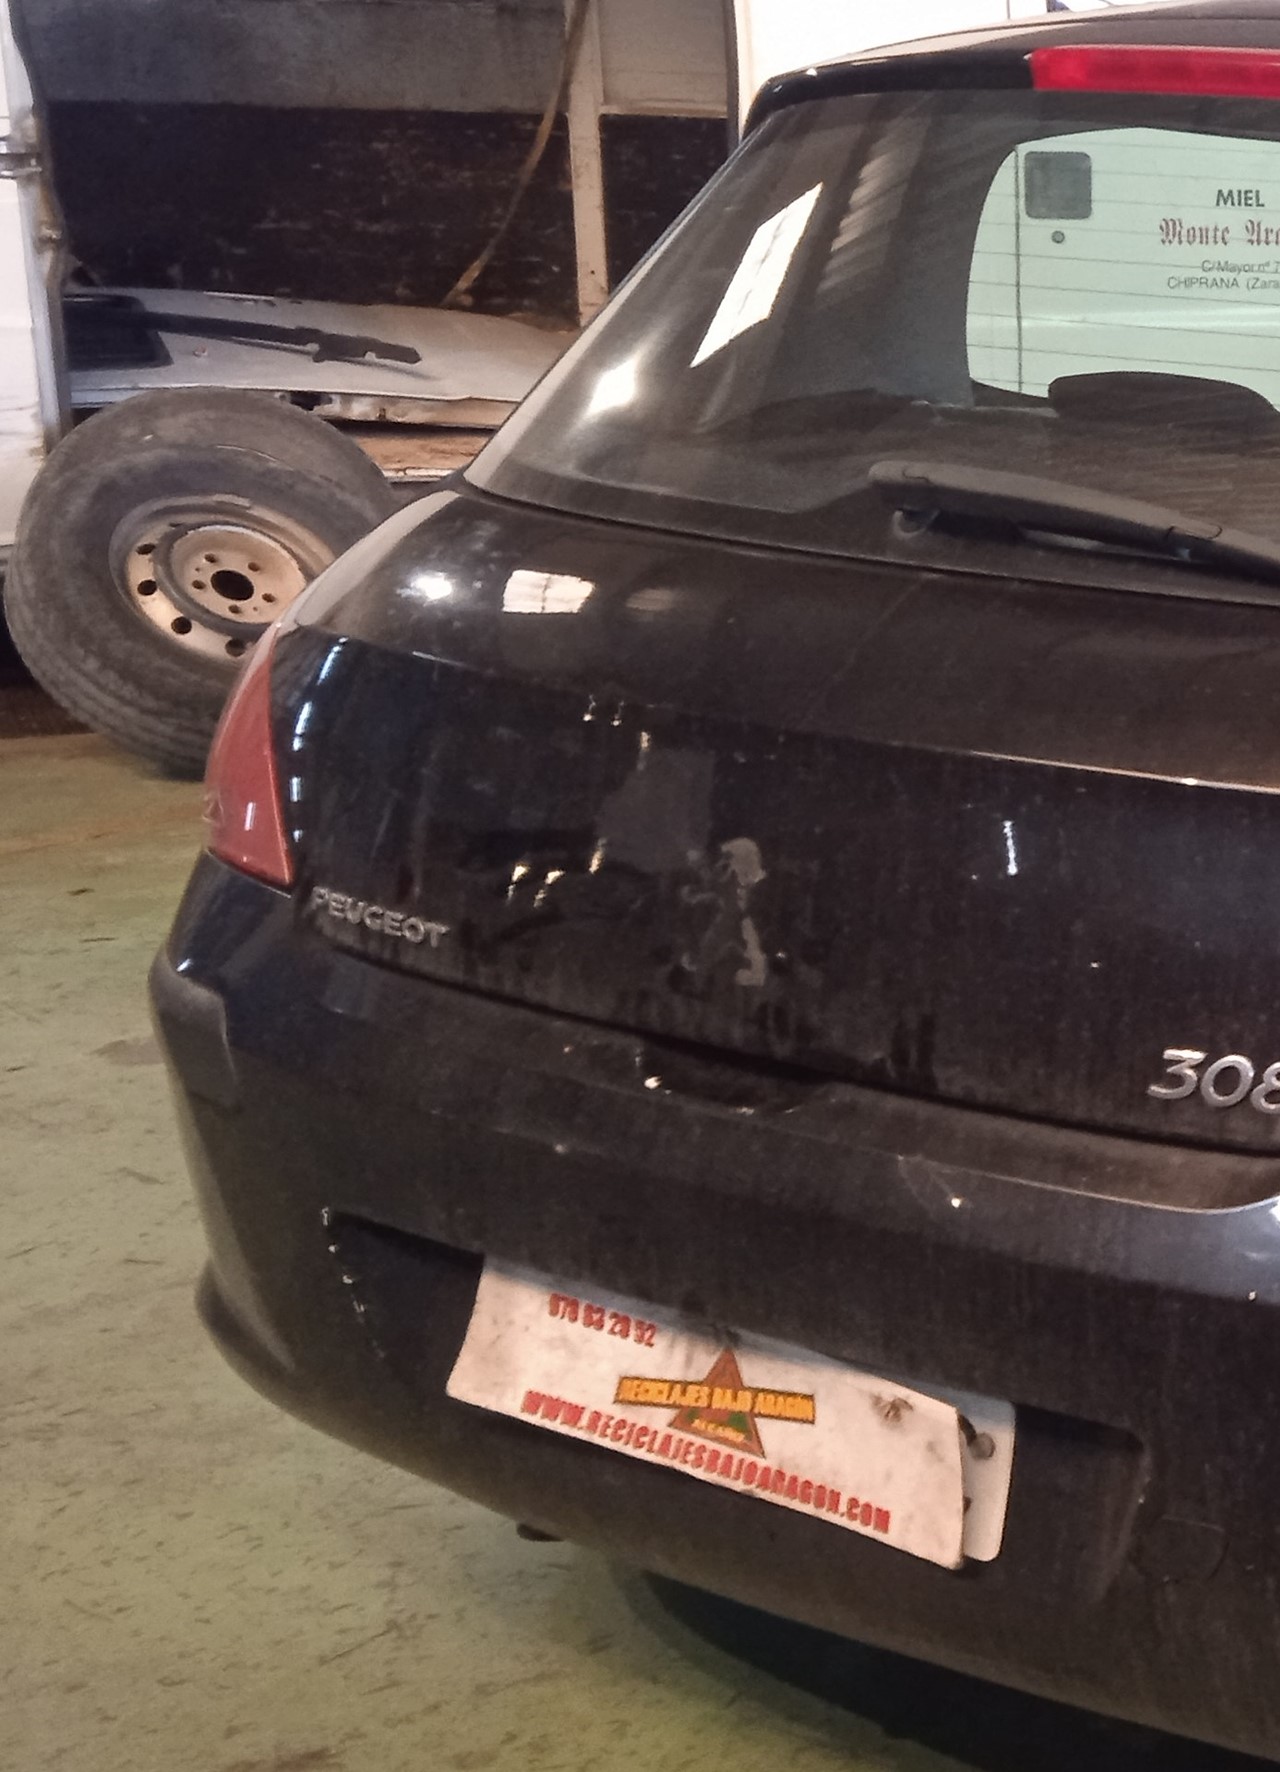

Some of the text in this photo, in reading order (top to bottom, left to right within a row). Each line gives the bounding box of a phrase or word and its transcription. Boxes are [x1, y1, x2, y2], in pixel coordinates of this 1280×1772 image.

[1215, 189, 1265, 208] MIEL
[1159, 217, 1230, 246] Monte
[1167, 276, 1240, 289] CHIPRANA
[310, 886, 450, 948] PEUGEOT
